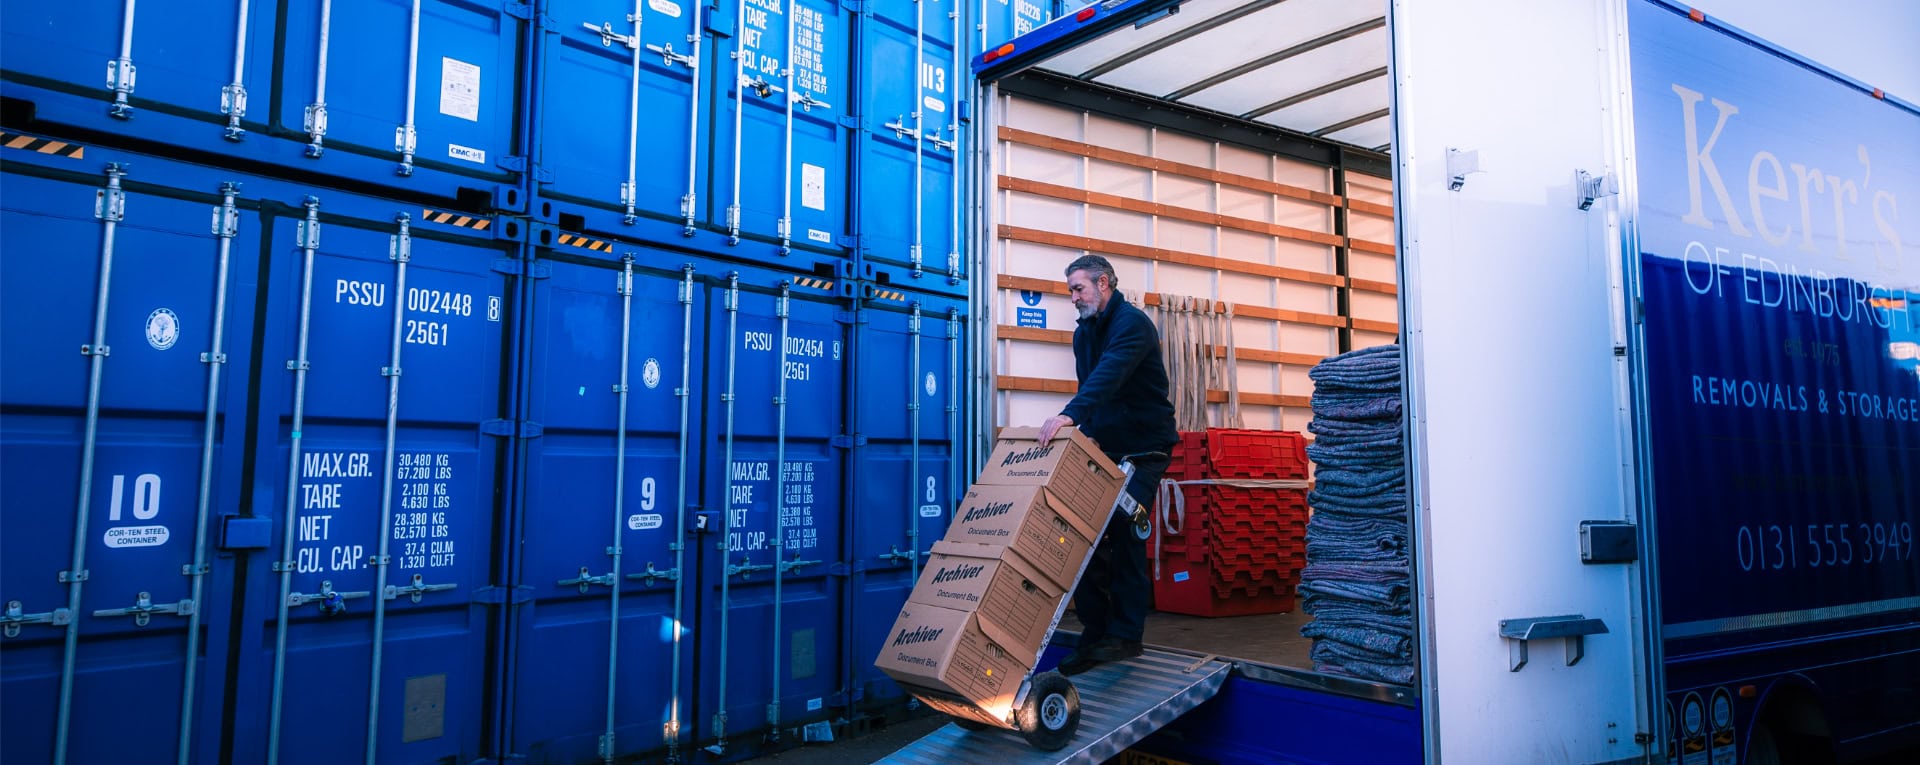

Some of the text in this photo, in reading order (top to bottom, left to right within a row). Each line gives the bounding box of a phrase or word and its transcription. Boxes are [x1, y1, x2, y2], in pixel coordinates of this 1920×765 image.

[746, 6, 767, 29] TARE
[744, 27, 762, 49] NET
[744, 50, 780, 77] CU. CAP.
[1671, 83, 1903, 274] Kerr's
[1684, 241, 1910, 333] OF EDINBURGH
[336, 280, 499, 320] PSSU 002448 8
[406, 320, 448, 346] 25G1
[745, 332, 840, 360] PSSU 002454 9
[785, 361, 810, 380] 25G1
[1692, 375, 1918, 422] REMOVALS & STORAGE
[303, 453, 372, 477] MAX.GR.
[436, 454, 448, 466] KG
[1001, 446, 1054, 467] Archiver
[435, 468, 452, 479] LBS
[732, 462, 770, 480] MAX.GR.
[804, 472, 814, 481] LBS
[109, 473, 161, 520] 10
[302, 484, 342, 509] TARE
[434, 483, 446, 495] KG
[641, 477, 656, 510] 9
[731, 486, 752, 504] TARE
[926, 476, 936, 502] 8
[433, 496, 450, 508] LBS
[803, 506, 810, 516] KG
[432, 512, 445, 524] KG
[730, 509, 747, 528] NET
[803, 516, 813, 526] LBS
[962, 502, 1014, 524] Archiver
[108, 529, 142, 537] COR-TEN
[300, 515, 332, 541] NET
[432, 526, 448, 538] LBS
[968, 528, 996, 536] Document
[117, 536, 157, 544] CONTAINER
[405, 541, 454, 556] 37.4 CU.M
[730, 532, 768, 551] CU. CAP.
[1737, 521, 1912, 571] 0131 555 3949
[298, 545, 367, 573] CU. CAP.
[430, 554, 455, 567] CU.FT
[932, 564, 984, 584] Archiver
[937, 589, 979, 602] Document Box
[901, 610, 910, 618] The
[892, 626, 943, 648] Archiver
[897, 652, 937, 668] Document Box
